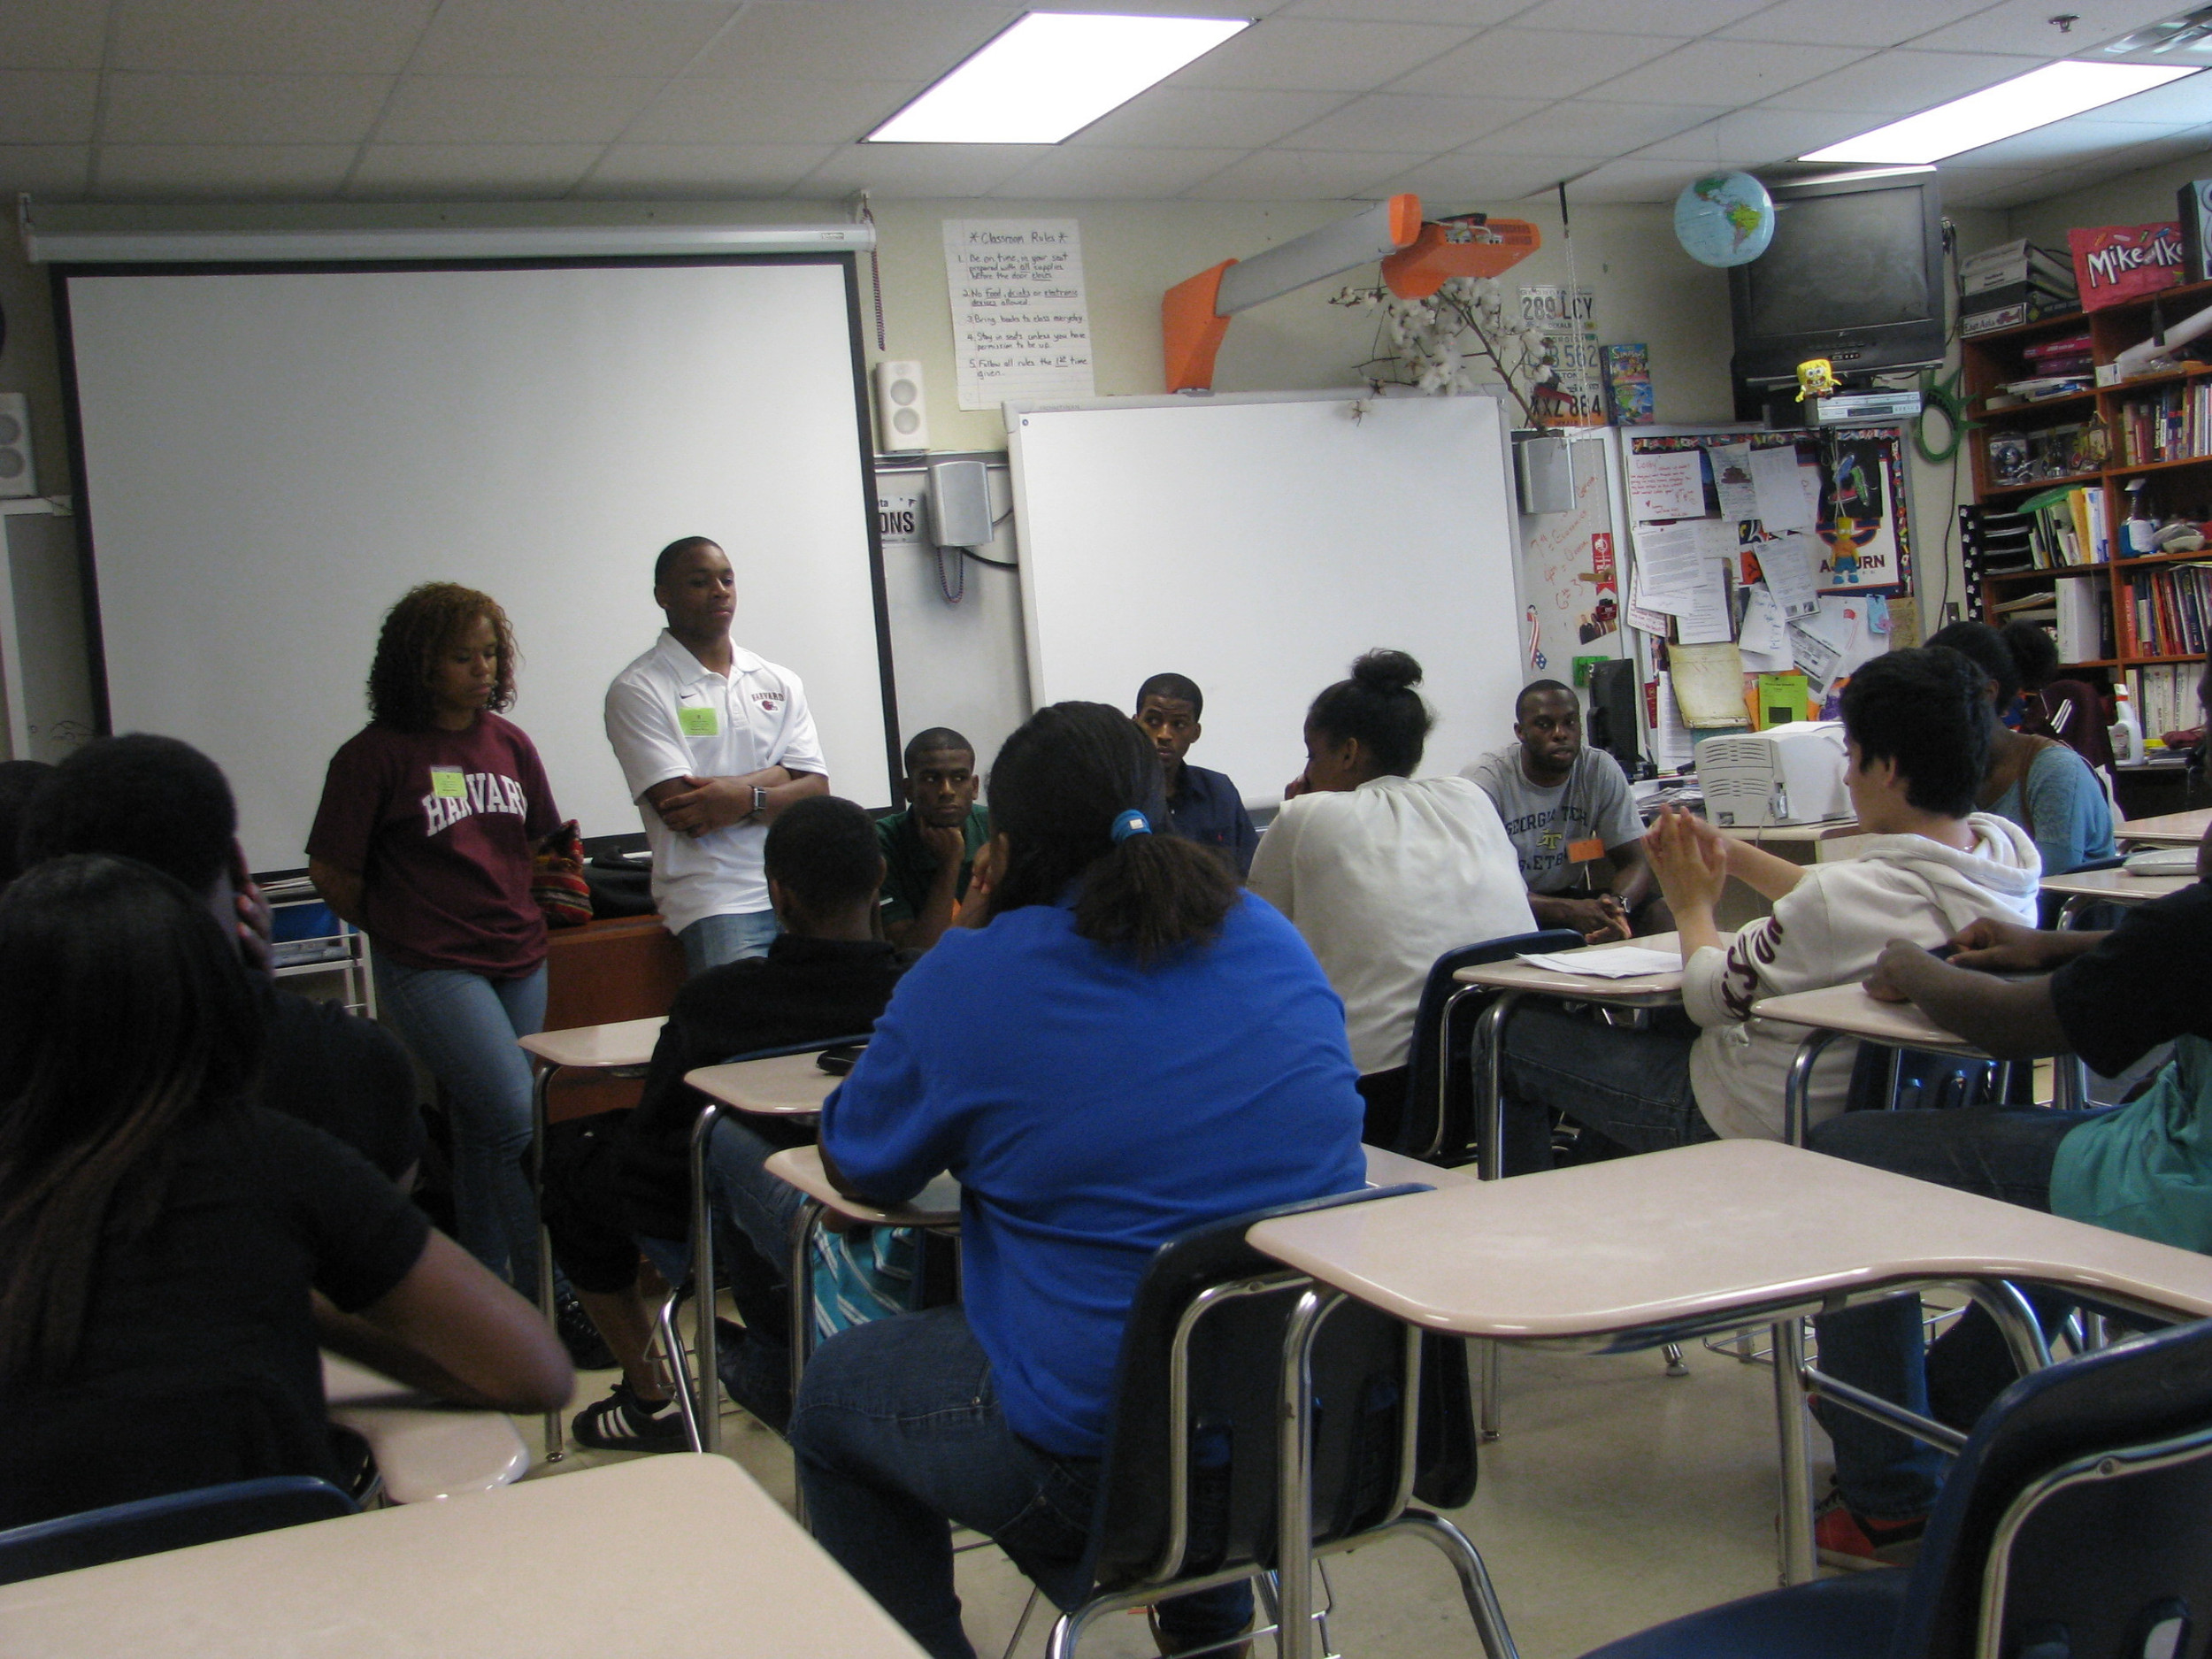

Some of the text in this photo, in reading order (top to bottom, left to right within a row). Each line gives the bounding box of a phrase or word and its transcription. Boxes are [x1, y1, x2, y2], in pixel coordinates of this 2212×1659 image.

[980, 231, 1056, 244] Classroom Rules
[2086, 245, 2144, 288] Mike
[1522, 296, 1593, 320] 289 LCY
[974, 314, 996, 326] Bring
[976, 332, 993, 342] Stay
[979, 359, 1001, 368] Follow
[1003, 358, 1014, 367] all
[1070, 356, 1087, 365] time
[1563, 344, 1599, 368] 562
[751, 692, 786, 703] HARVARD
